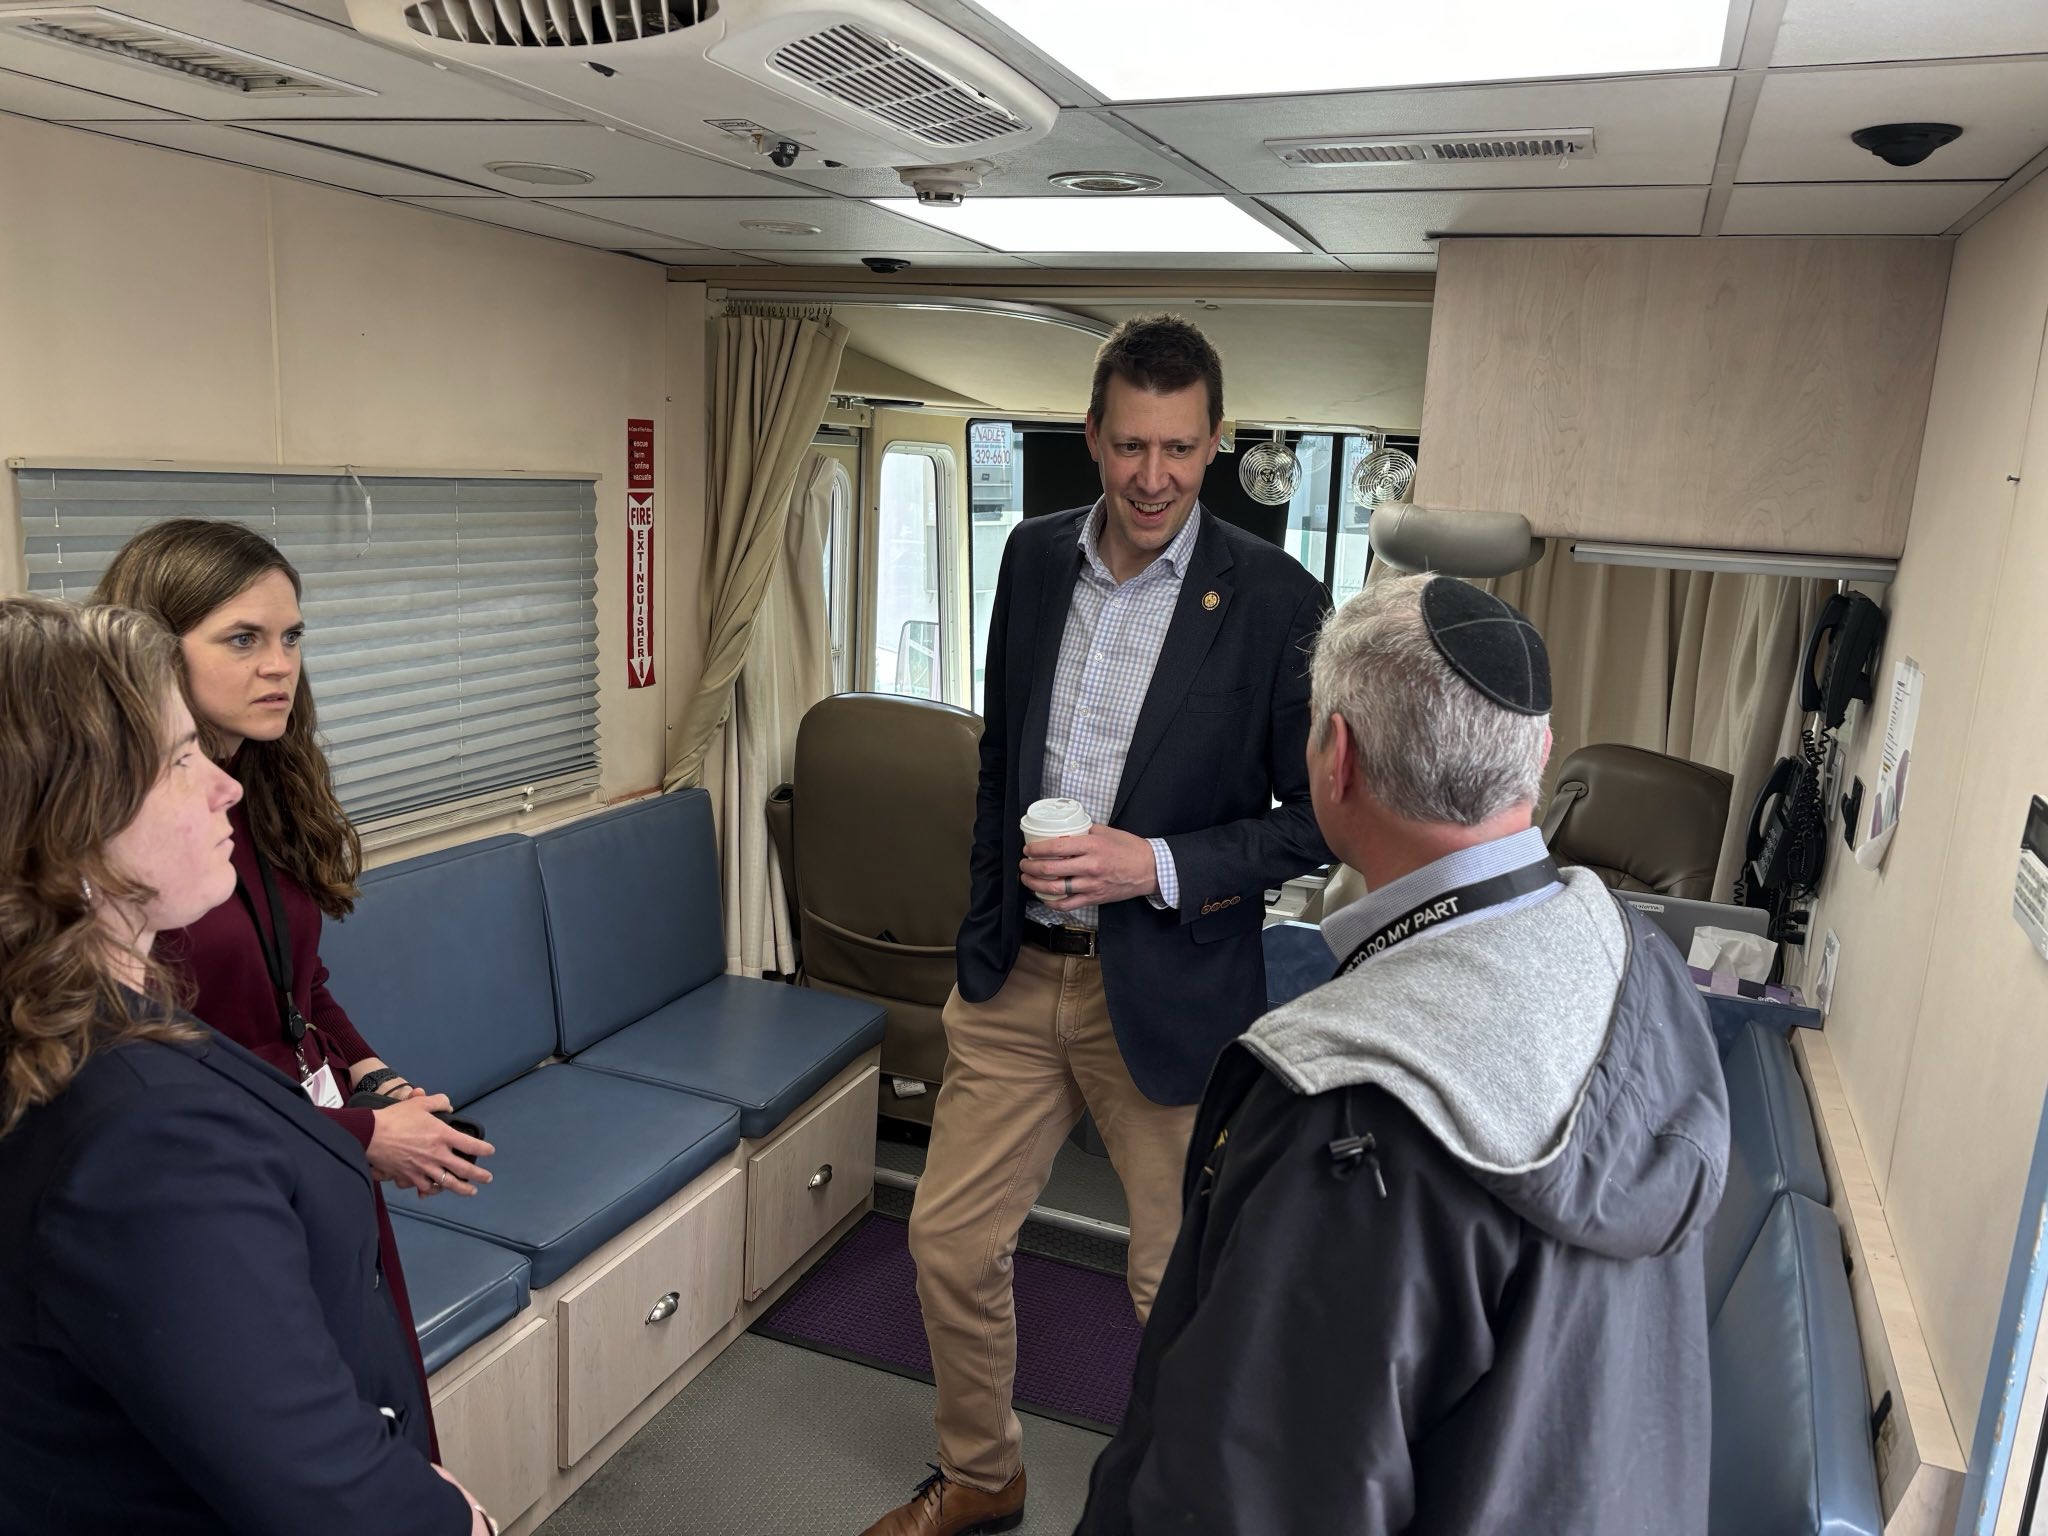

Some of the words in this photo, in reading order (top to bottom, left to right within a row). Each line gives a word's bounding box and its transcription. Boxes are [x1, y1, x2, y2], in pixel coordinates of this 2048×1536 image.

[974, 426, 1005, 442] NADLER
[631, 507, 651, 526] FIRE
[636, 529, 645, 658] EXTINGUISHER
[1367, 935, 1386, 956] DO
[1387, 919, 1410, 944] MY
[1413, 896, 1459, 929] PART
